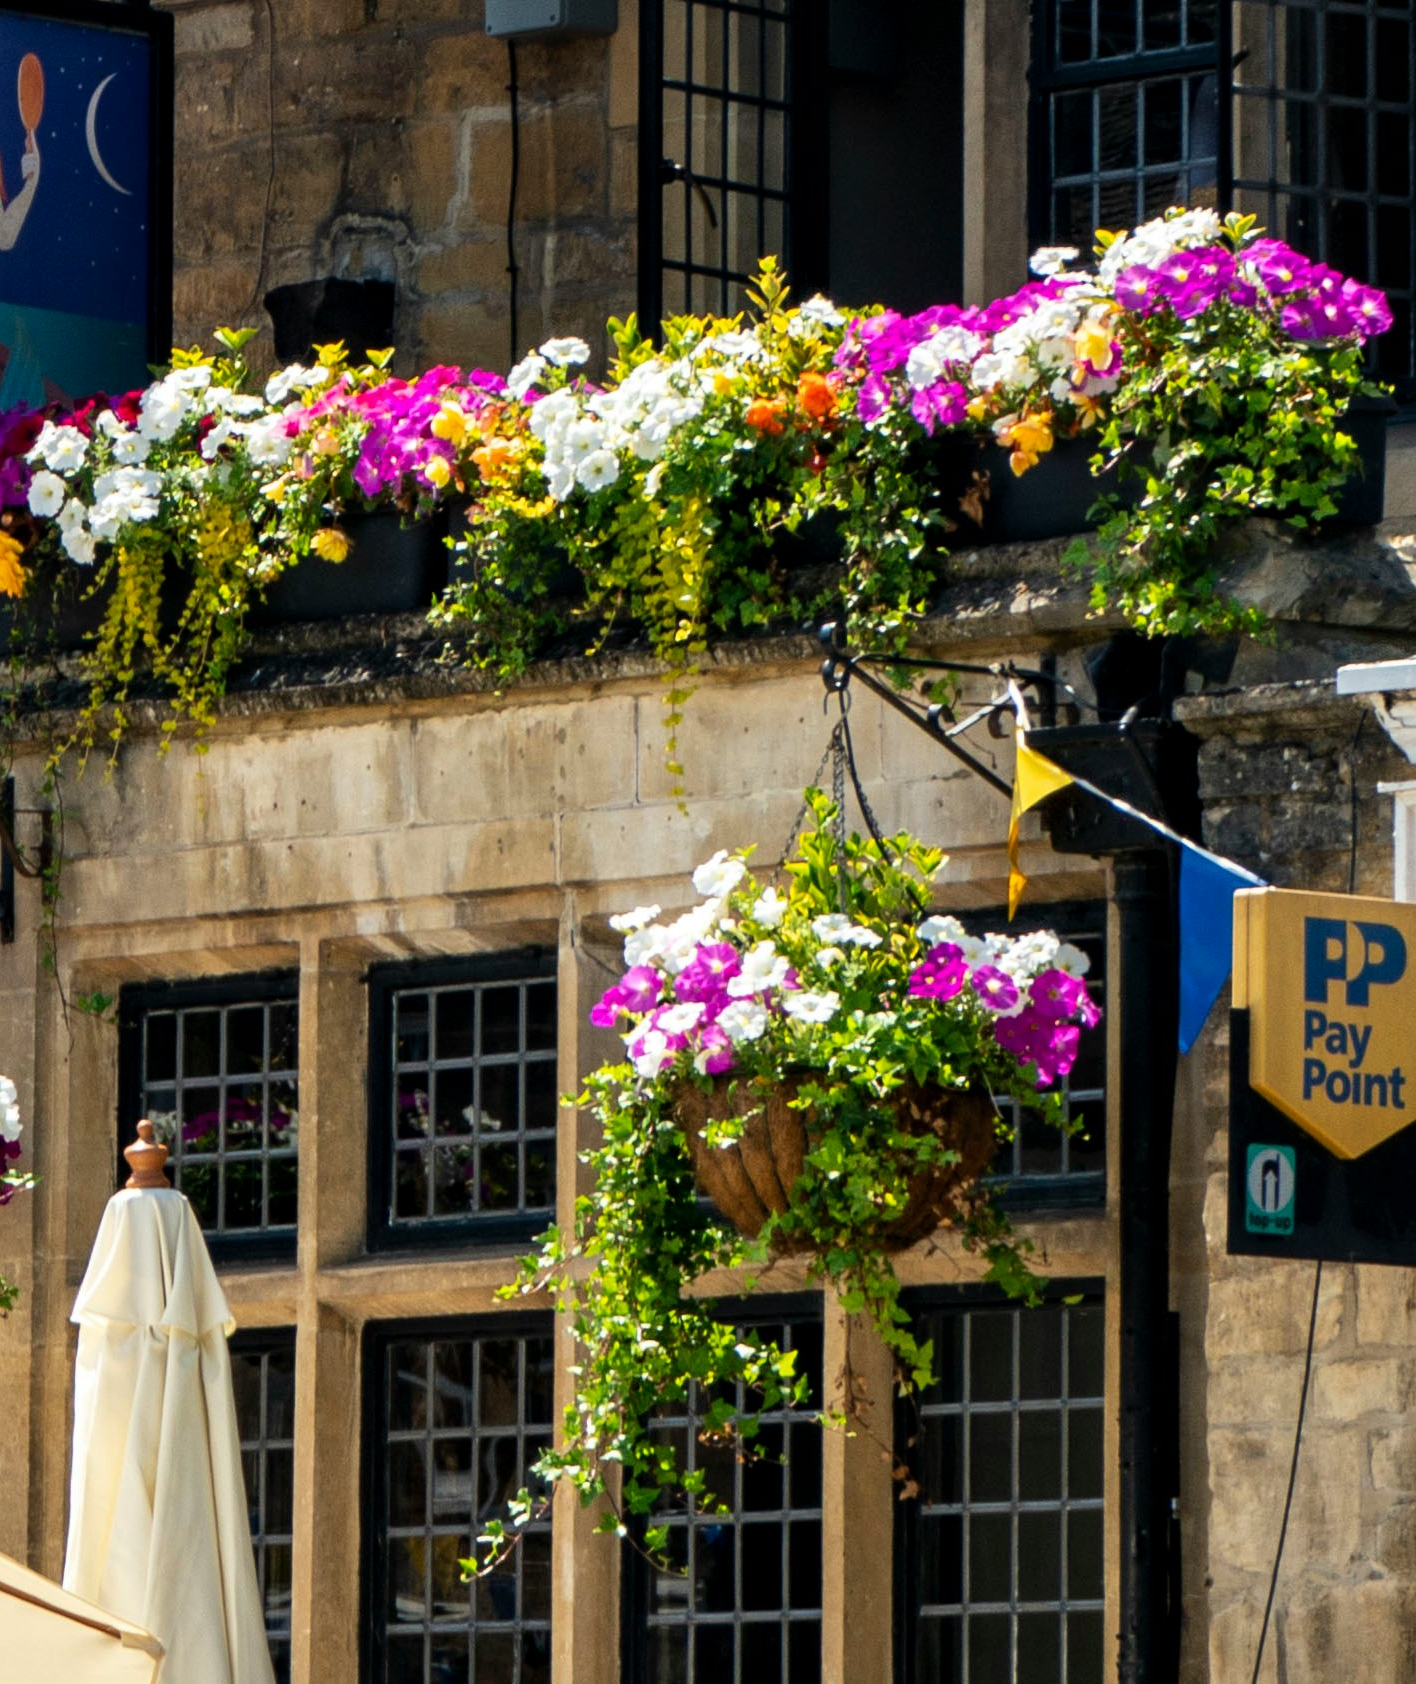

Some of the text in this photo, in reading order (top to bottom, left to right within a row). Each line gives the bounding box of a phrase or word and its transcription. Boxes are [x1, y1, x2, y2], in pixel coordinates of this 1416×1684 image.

[1304, 1010, 1373, 1069] Pay
[1302, 1058, 1406, 1109] Point
[1248, 1213, 1292, 1231] top-up
